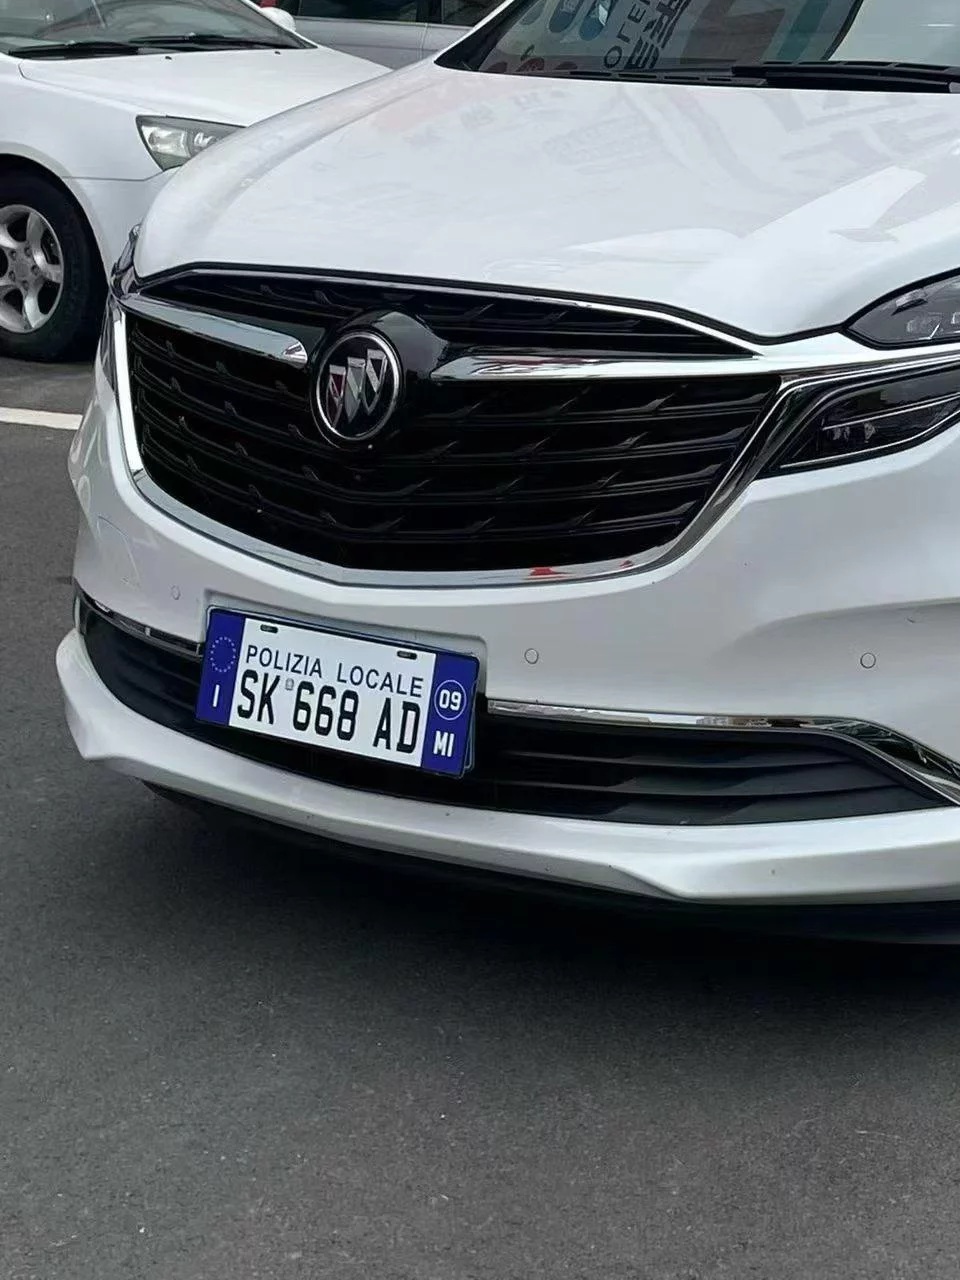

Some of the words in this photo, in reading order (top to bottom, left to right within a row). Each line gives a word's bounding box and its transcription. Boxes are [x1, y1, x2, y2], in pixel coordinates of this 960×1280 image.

[246, 644, 322, 678] POLIZIA
[337, 662, 424, 698] LOCALE
[237, 669, 281, 725] SK
[292, 681, 359, 741] 668
[373, 697, 421, 754] AD
[438, 688, 460, 711] 09
[433, 730, 455, 757] MI
